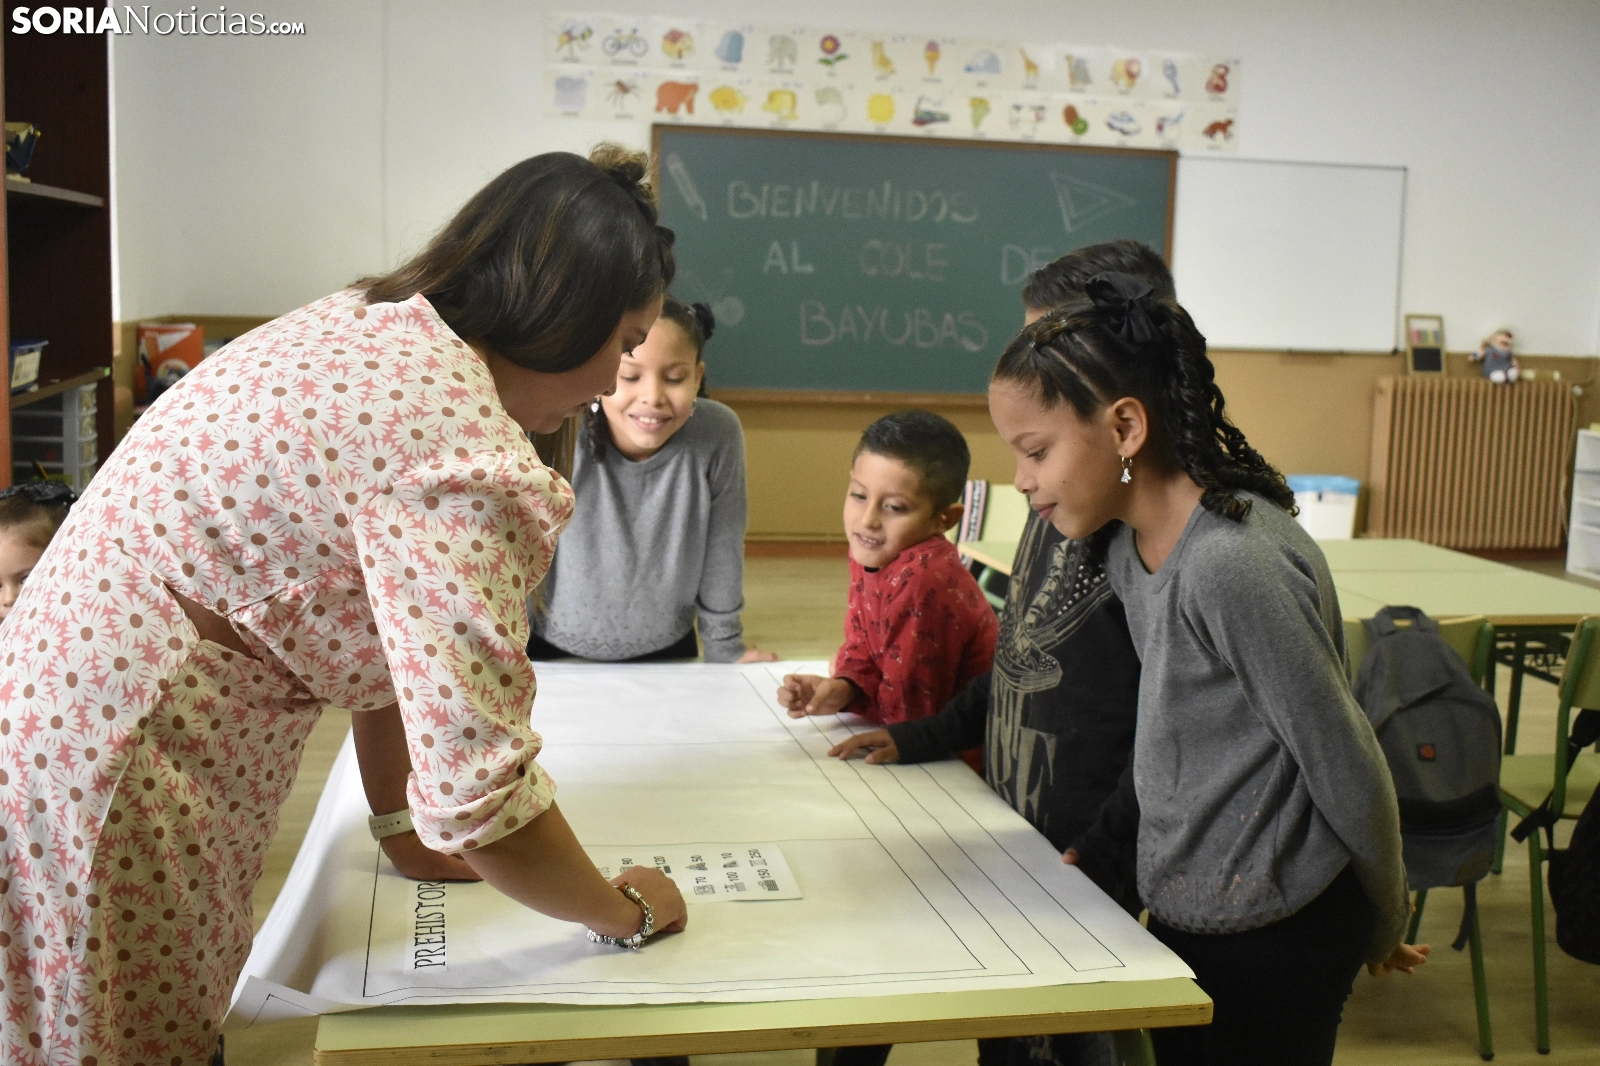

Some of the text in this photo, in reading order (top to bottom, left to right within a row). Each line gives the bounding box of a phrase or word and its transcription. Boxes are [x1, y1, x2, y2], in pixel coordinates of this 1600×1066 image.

[727, 179, 980, 224] BIENVENIDOS
[763, 239, 814, 274] AL
[859, 239, 949, 282] COLE
[799, 299, 988, 352] BAYUBAS
[748, 849, 762, 859] 250
[695, 876, 707, 884] 70
[726, 872, 740, 881] 100
[757, 869, 771, 879] 150
[413, 880, 446, 969] PREHISTOR
